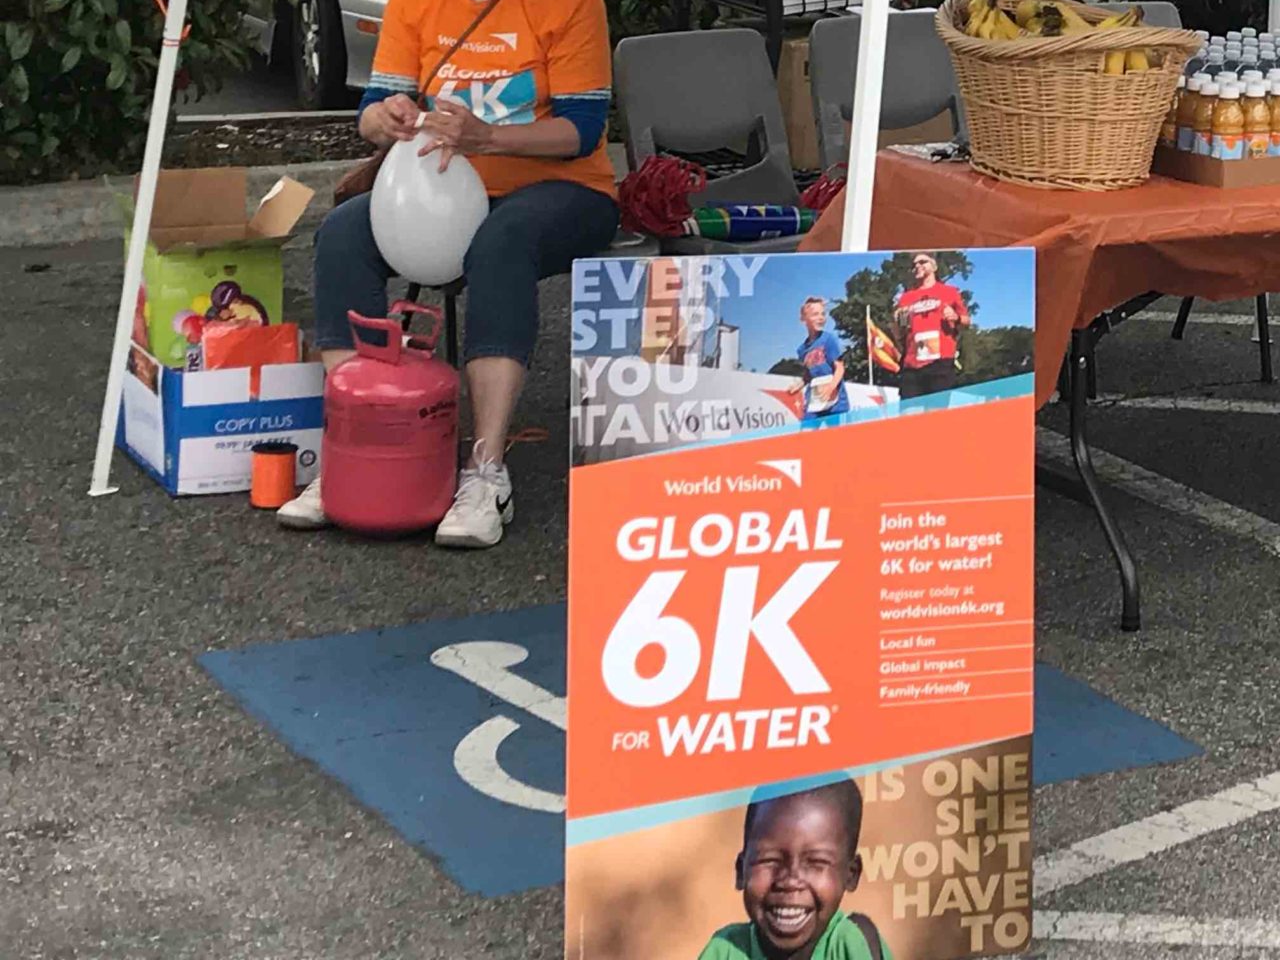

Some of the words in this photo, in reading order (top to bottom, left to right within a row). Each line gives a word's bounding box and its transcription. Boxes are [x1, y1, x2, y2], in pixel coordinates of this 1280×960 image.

[573, 256, 769, 304] EVERY
[571, 305, 714, 352] STEP
[572, 353, 699, 400] YOU
[215, 418, 257, 433] COPY
[260, 415, 294, 429] PLUS
[571, 399, 733, 447] TAKE
[659, 405, 731, 435] World
[733, 406, 785, 429] Vision
[664, 476, 721, 496] World
[726, 474, 782, 493] Vision
[616, 507, 843, 561] GLOBAL
[879, 513, 912, 534] Join
[918, 512, 946, 527] the
[880, 534, 941, 553] world's
[945, 532, 1003, 551] largest
[880, 559, 903, 575] 6K
[908, 557, 933, 573] for
[938, 553, 992, 570] water!
[880, 587, 925, 603] Register
[929, 585, 960, 599] today
[963, 584, 974, 596] at
[880, 601, 1005, 620] worldvision6k.org
[601, 560, 842, 708] 6K
[880, 636, 913, 650] Local
[916, 635, 936, 647] fun
[880, 661, 920, 674] Global
[923, 658, 966, 673] impact
[880, 681, 970, 699] Family-friendly
[612, 731, 650, 751] FOR
[656, 705, 831, 758] WATER
[864, 765, 906, 803] IS
[922, 753, 1029, 798] ONE
[935, 794, 1029, 838] SHE
[860, 833, 1030, 883] WON'T
[892, 873, 1029, 920] HAVE
[960, 911, 1029, 952] TO
